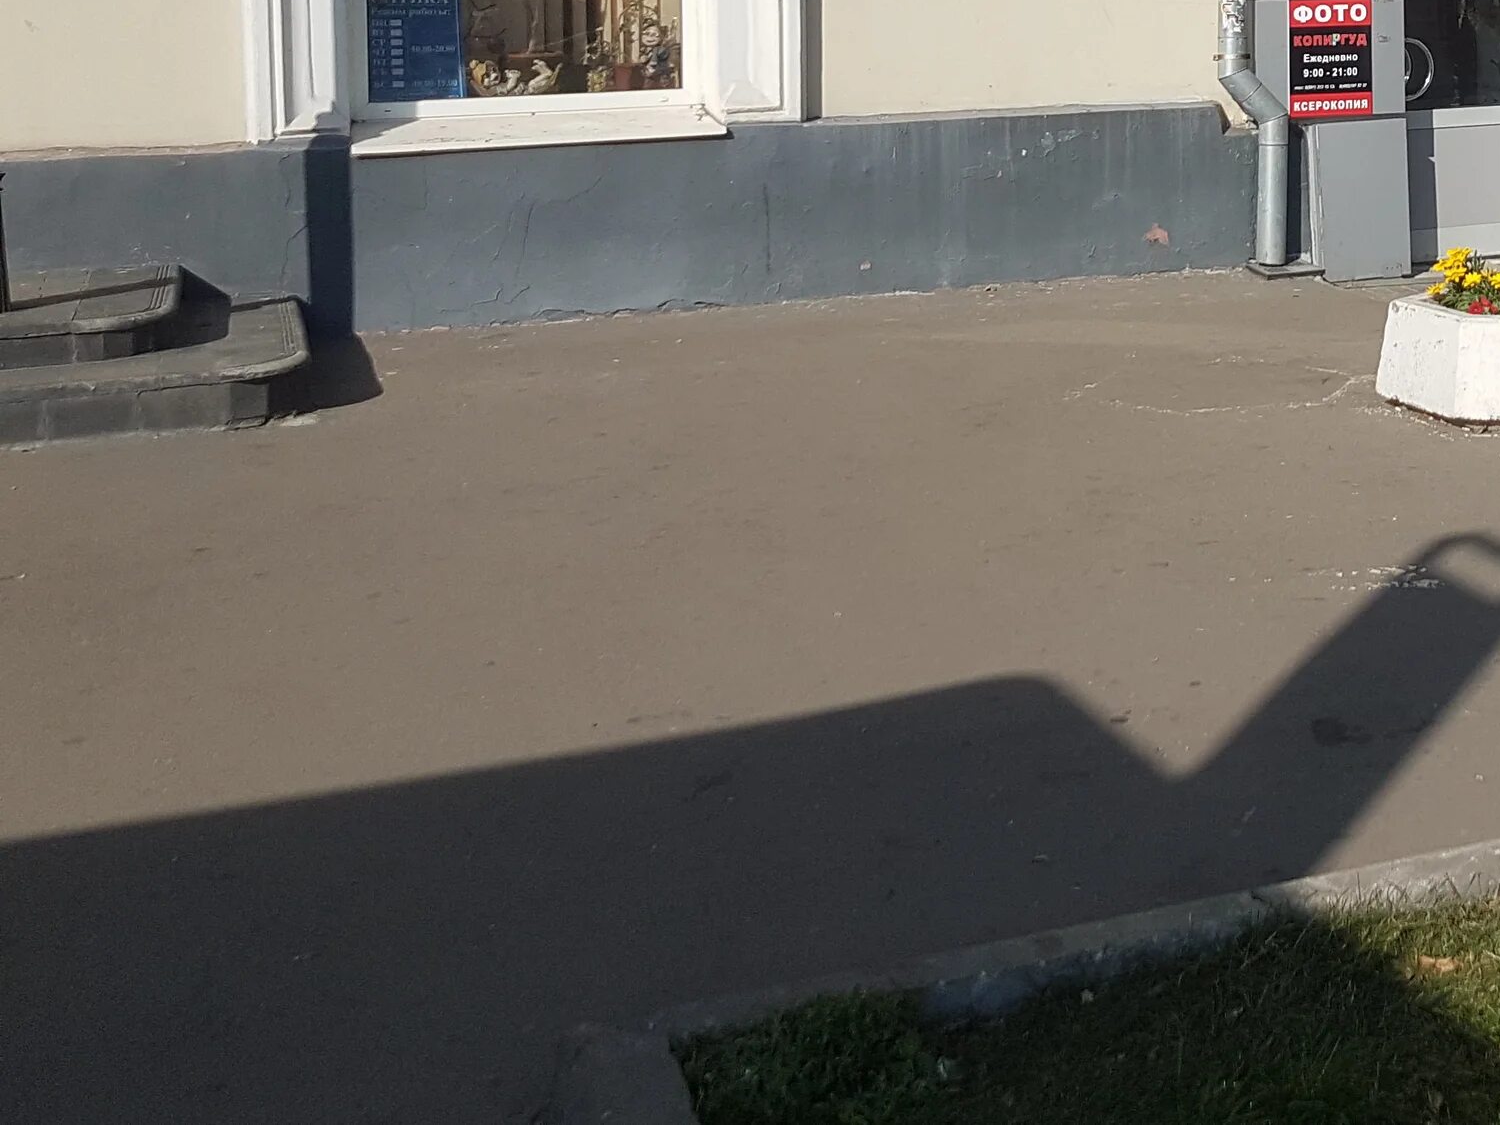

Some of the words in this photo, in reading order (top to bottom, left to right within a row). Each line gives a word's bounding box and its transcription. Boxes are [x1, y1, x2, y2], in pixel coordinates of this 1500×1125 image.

[1293, 3, 1367, 23] ФОТО
[1303, 53, 1358, 64] Ежедневно
[1303, 68, 1324, 78] 9:00
[1332, 67, 1358, 77] 21:00
[1293, 99, 1368, 112] КСЕРОКОПИЯ
